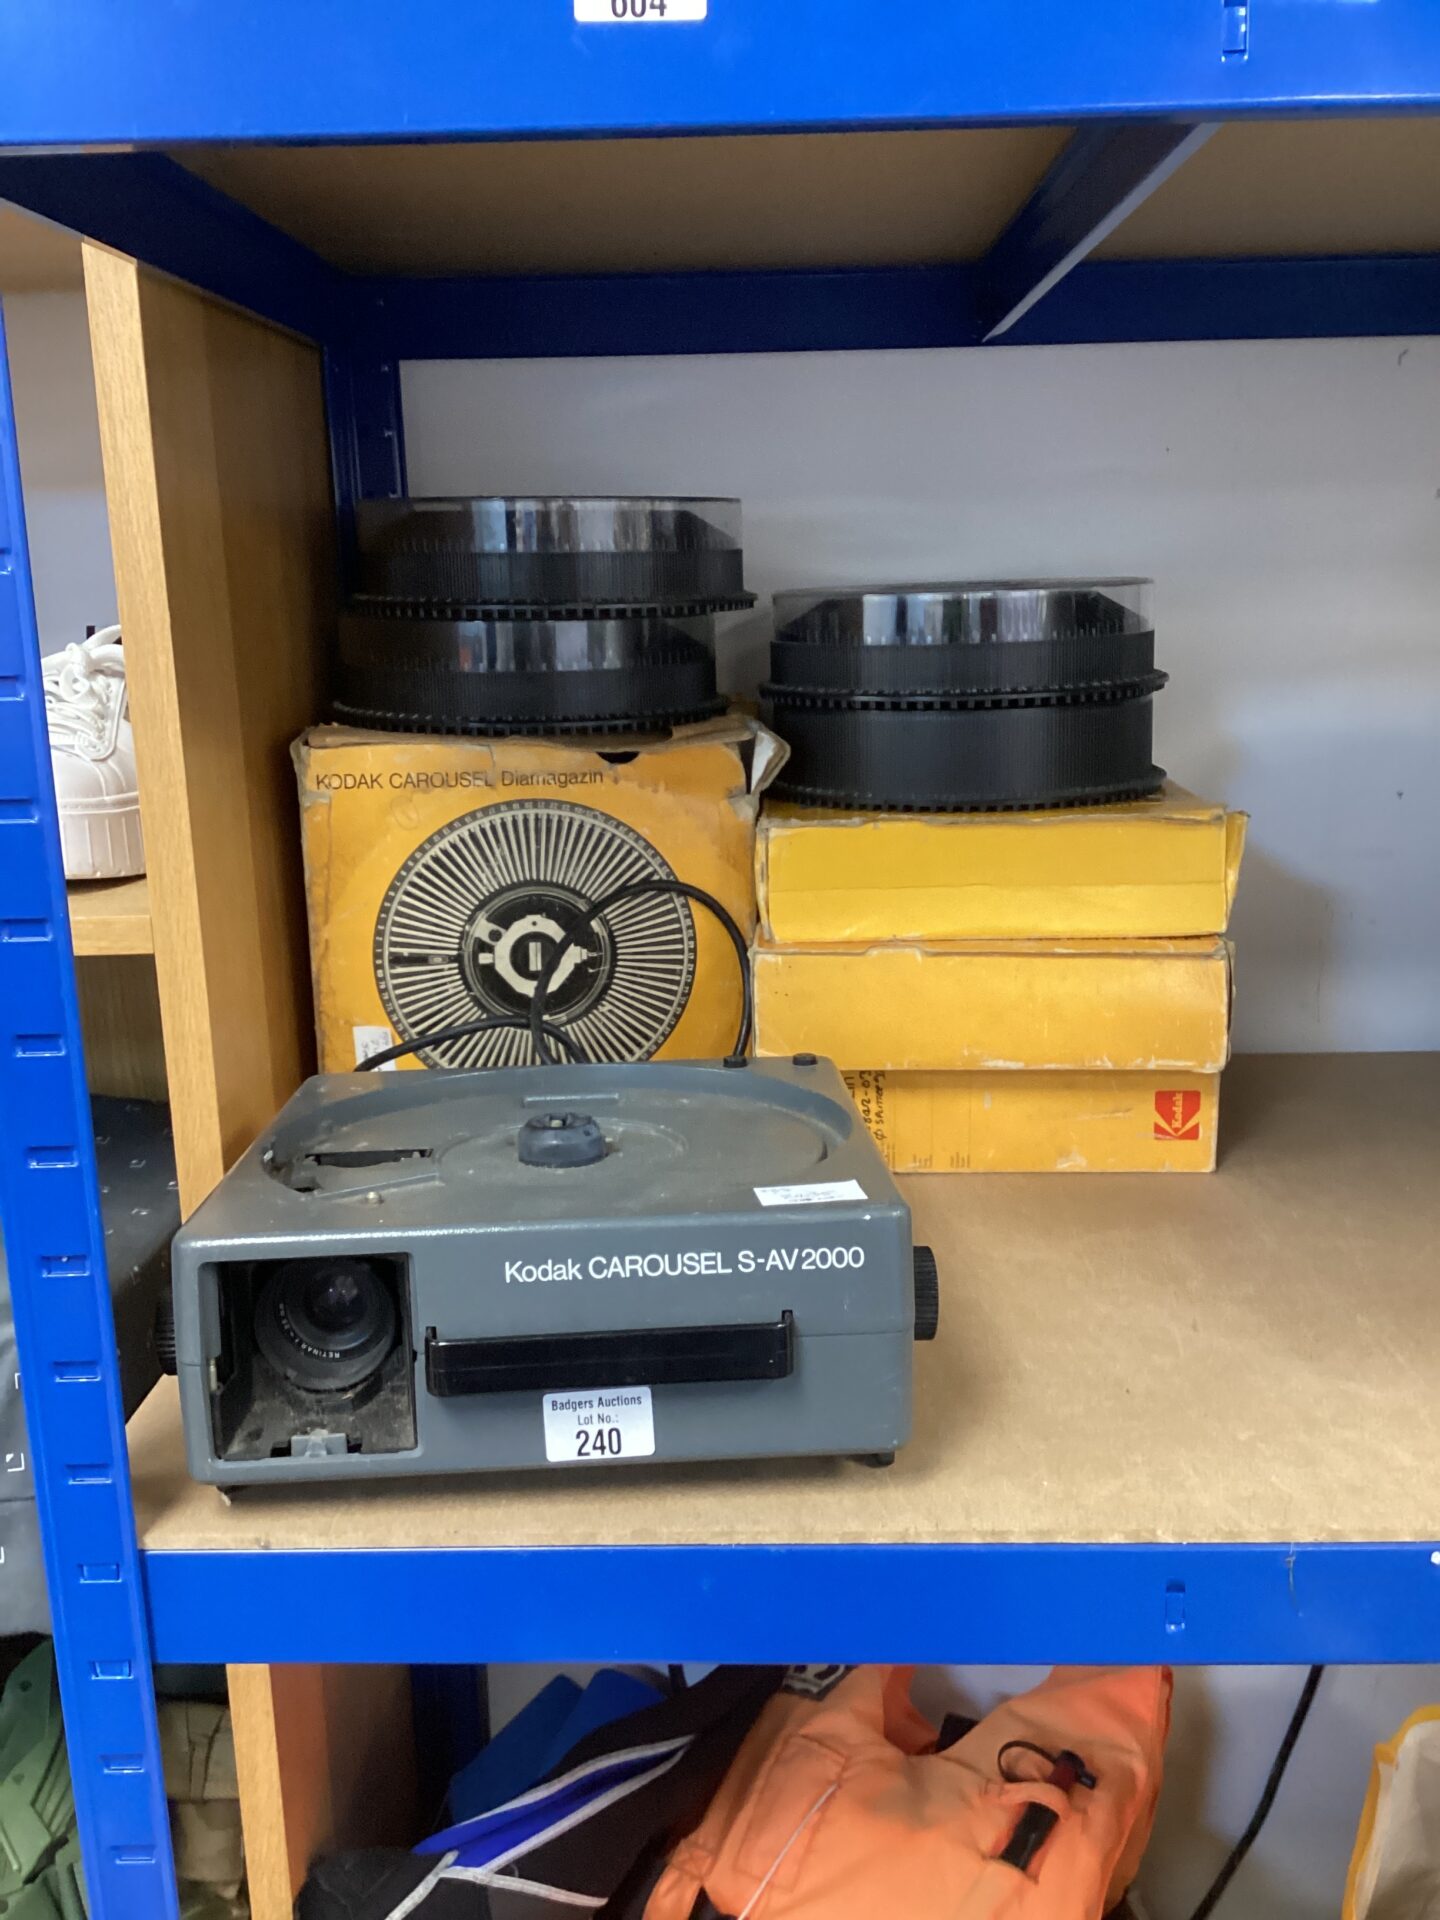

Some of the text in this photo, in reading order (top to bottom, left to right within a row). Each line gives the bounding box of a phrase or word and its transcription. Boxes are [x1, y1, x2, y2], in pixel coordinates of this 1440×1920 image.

[316, 772, 384, 790] KODAK
[389, 770, 496, 789] CAROUSEL
[1171, 1092, 1183, 1128] Kodak
[505, 1257, 583, 1283] Kodak
[588, 1252, 732, 1279] CAROUSEL
[551, 1395, 642, 1413] Badgers Auctions
[577, 1414, 593, 1426] Lot
[576, 1427, 622, 1457] 240
